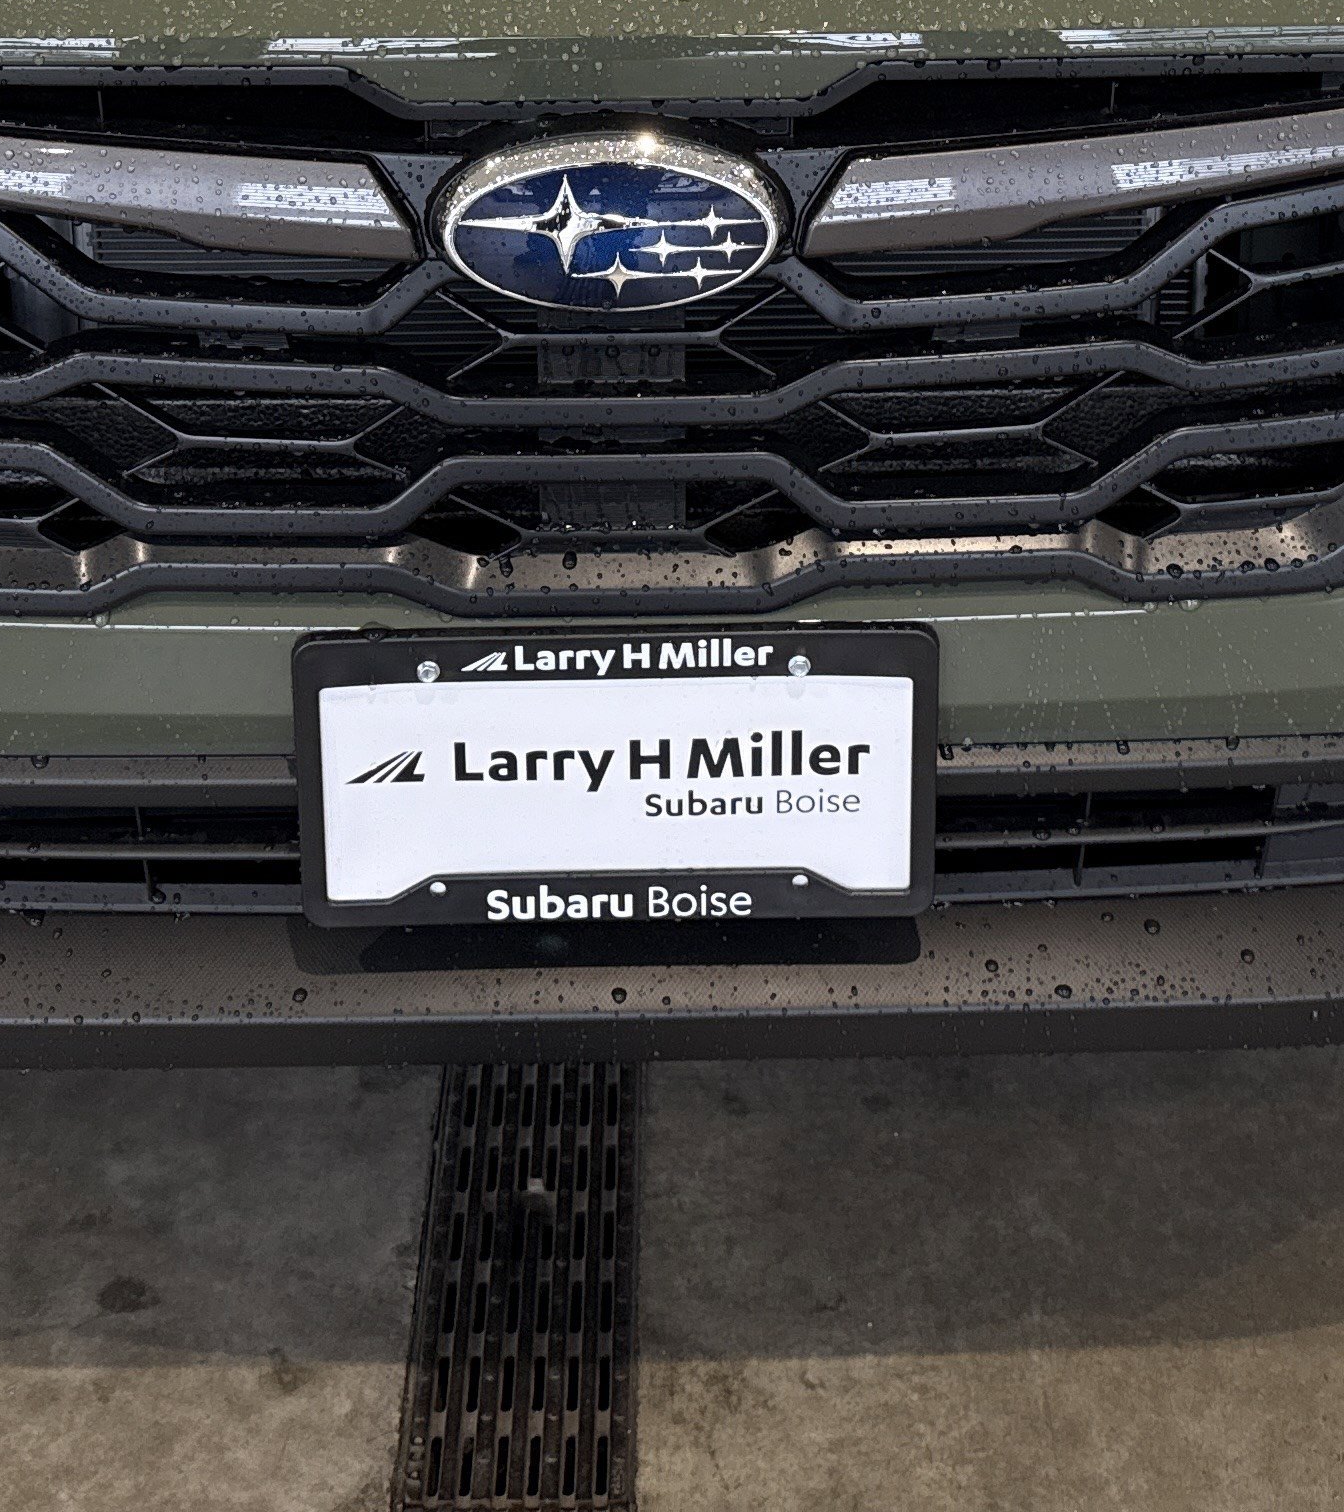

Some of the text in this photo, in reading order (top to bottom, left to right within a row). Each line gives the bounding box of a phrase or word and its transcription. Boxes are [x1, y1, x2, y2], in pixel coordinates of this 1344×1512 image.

[515, 638, 773, 675] Larry H Miller
[454, 730, 870, 792] Larry H Miller
[646, 790, 860, 816] Subaru Boise
[487, 885, 752, 920] Subaru Boise
